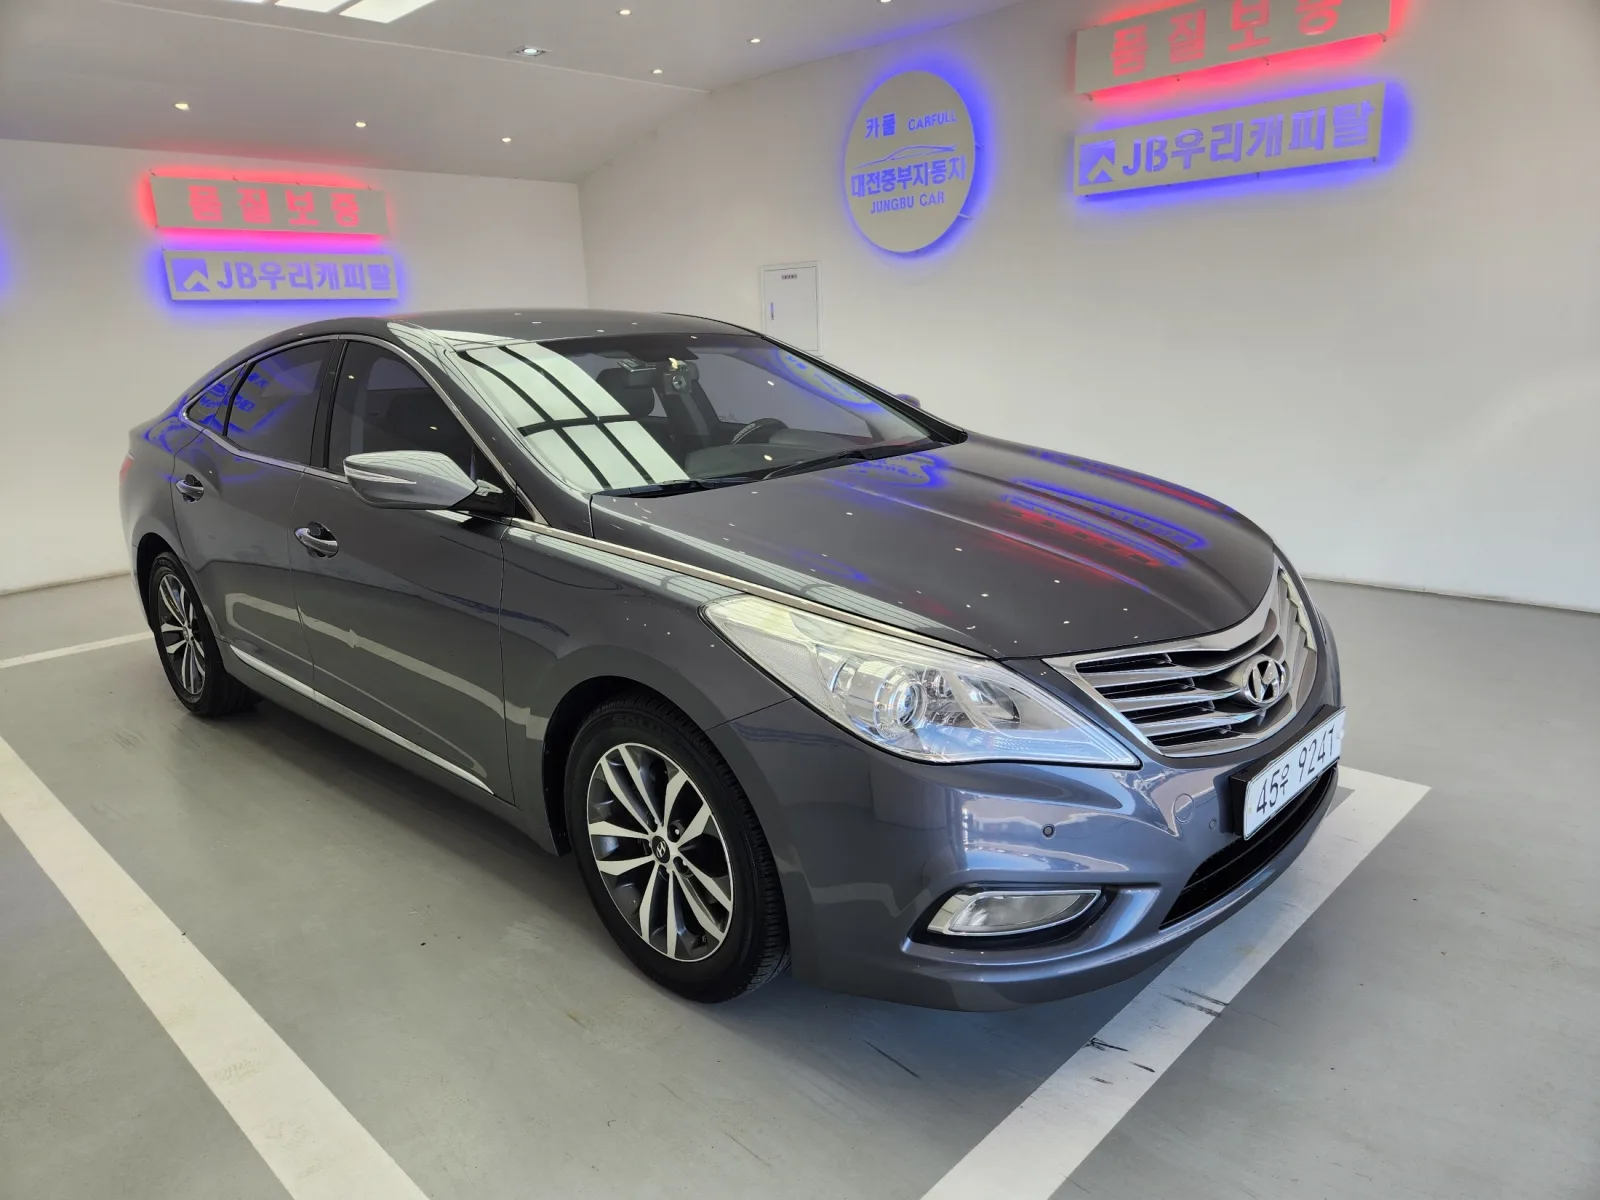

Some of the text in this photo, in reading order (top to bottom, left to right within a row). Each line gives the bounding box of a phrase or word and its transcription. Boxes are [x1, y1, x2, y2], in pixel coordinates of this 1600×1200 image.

[908, 111, 957, 131] CARFULL
[1122, 101, 1374, 175] JB우리캐피탈
[871, 191, 945, 214] JUNGBU CAR
[216, 261, 393, 292] JB우리캐피탈
[1256, 763, 1290, 814] 45우
